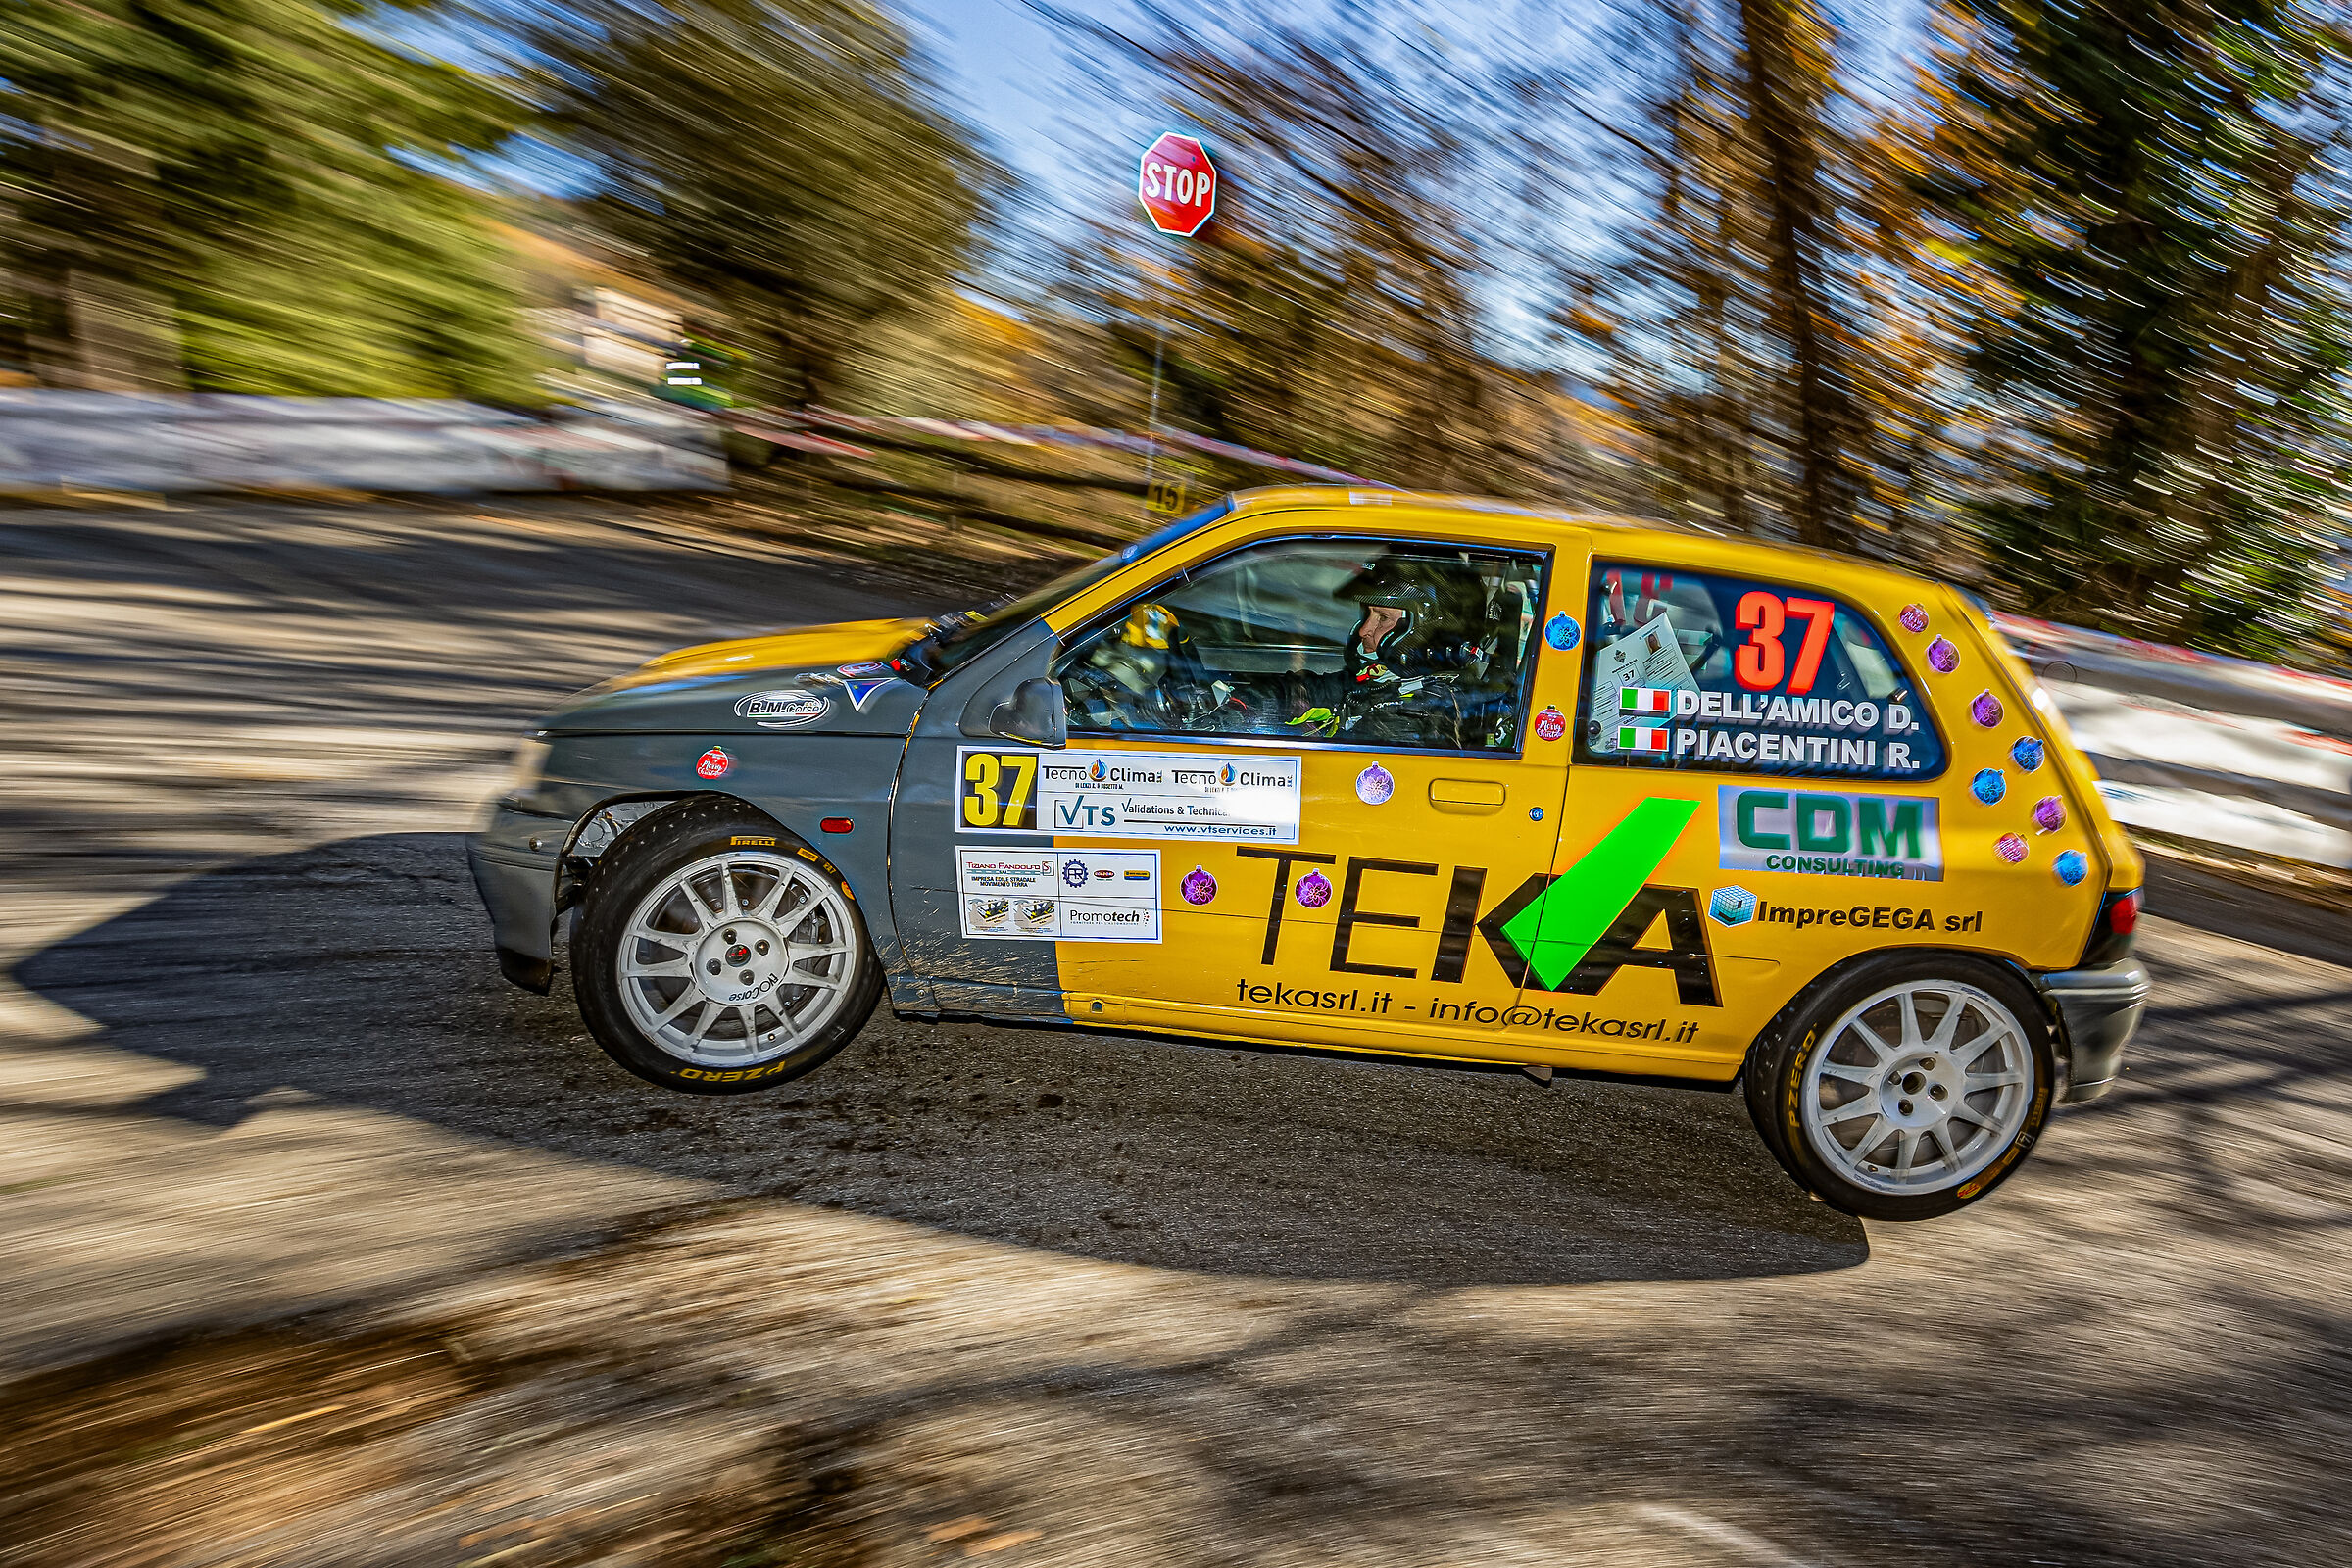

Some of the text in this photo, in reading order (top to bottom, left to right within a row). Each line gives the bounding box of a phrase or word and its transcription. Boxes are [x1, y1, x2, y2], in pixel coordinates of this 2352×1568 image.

[1145, 162, 1210, 207] STOP
[1735, 591, 1835, 695] 37
[1623, 670, 1635, 681] 37
[1677, 689, 1920, 731] DELL'AMICO D.
[1676, 728, 1920, 769] PIACENTINI R.
[964, 753, 1038, 826] 37
[1042, 765, 1088, 781] Tecno
[1109, 767, 1156, 783] Clima
[1171, 769, 1217, 784] Tecno
[1240, 771, 1286, 787] Clima
[1059, 794, 1116, 827] VTS
[1121, 798, 1175, 814] Validations
[1177, 806, 1185, 815] &
[1163, 825, 1277, 836] www.vtservices.it
[1737, 790, 1923, 858] CDM
[730, 835, 777, 847] PIRELLI
[1766, 855, 1904, 877] CONSULTING
[1070, 909, 1140, 922] Promotech
[1236, 845, 1725, 1008] TEKA
[1757, 901, 1984, 932] ImpreGEGA srl
[1236, 978, 1393, 1015] tekasrl.it
[1429, 996, 1699, 1045] info@tekasrl.it
